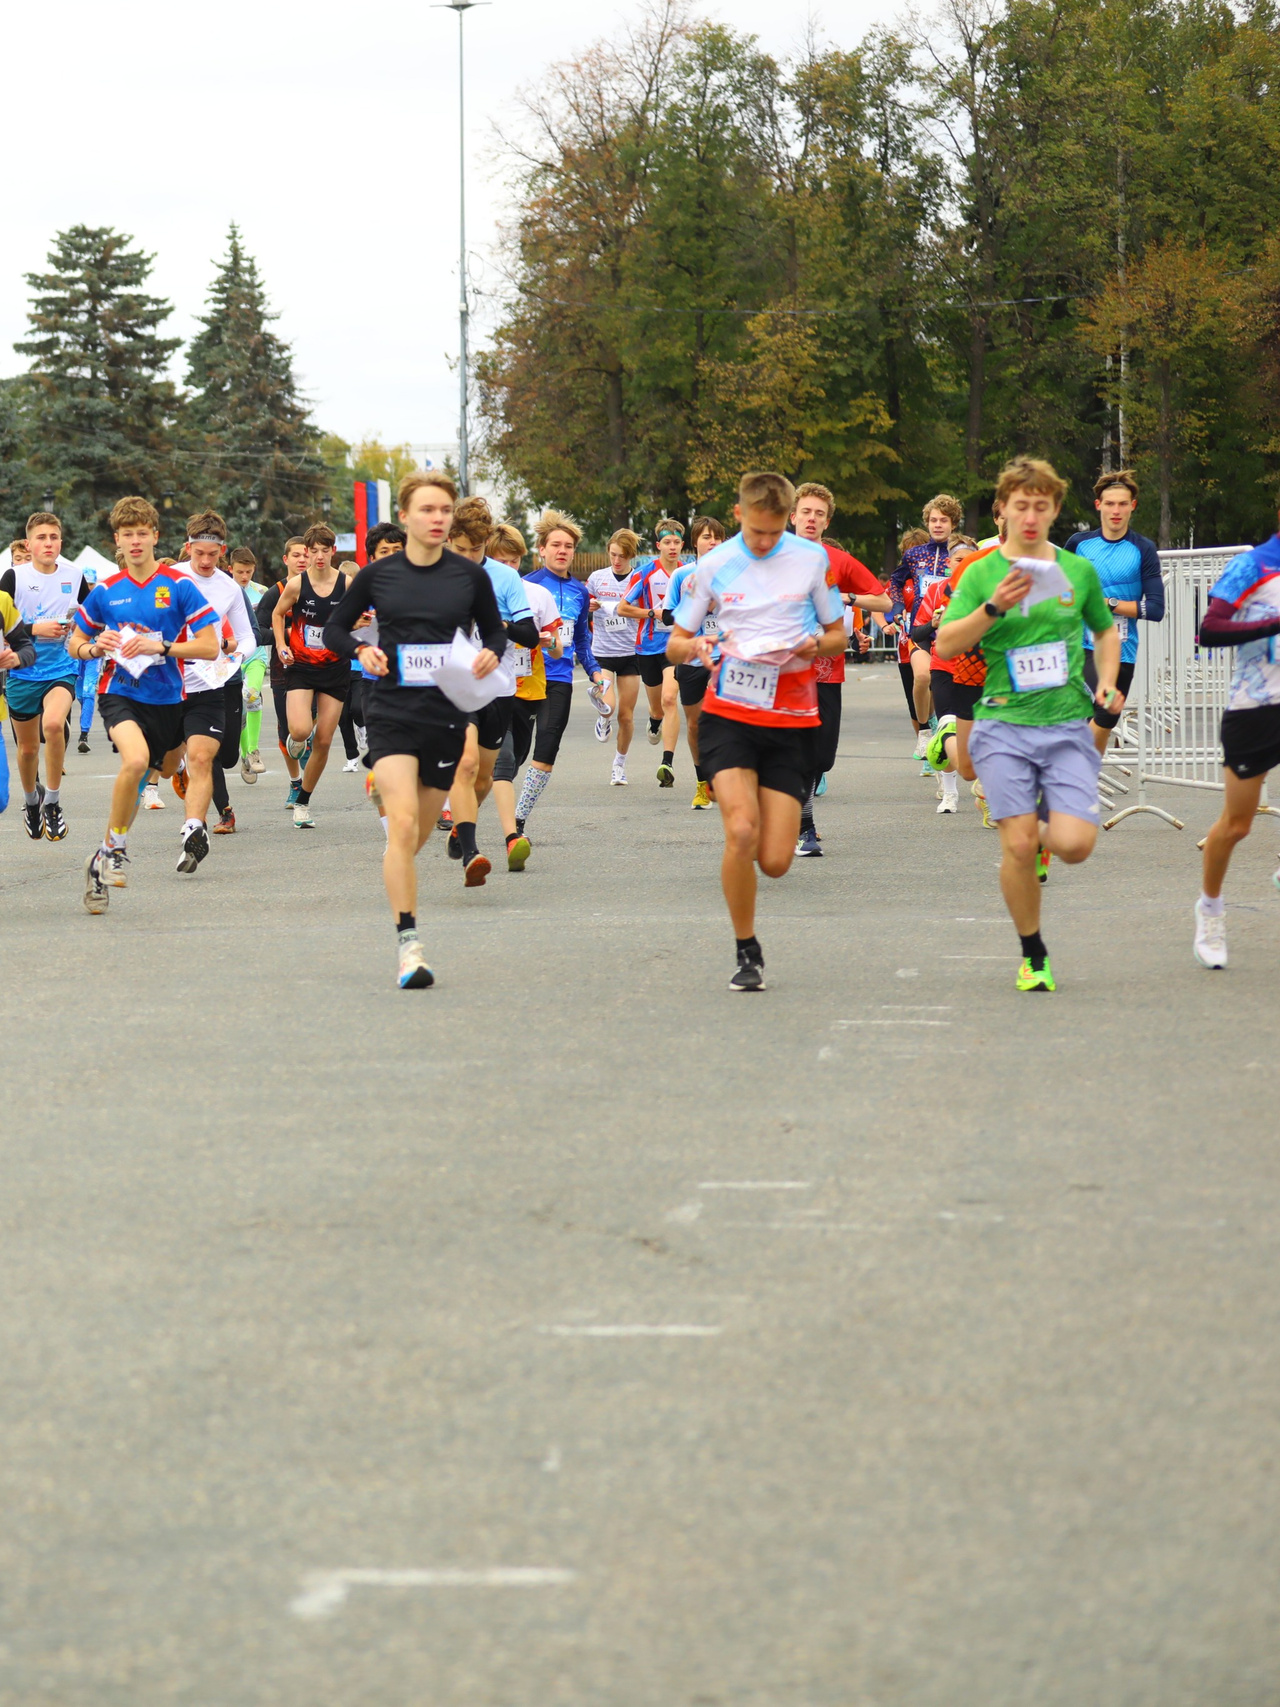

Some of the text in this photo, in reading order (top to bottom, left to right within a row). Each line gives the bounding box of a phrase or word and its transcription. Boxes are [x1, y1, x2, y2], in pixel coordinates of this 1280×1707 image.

[605, 617, 626, 626] 361.1
[405, 655, 445, 669] 308.1
[1017, 656, 1059, 675] 312.1
[727, 669, 767, 690] 327.1
